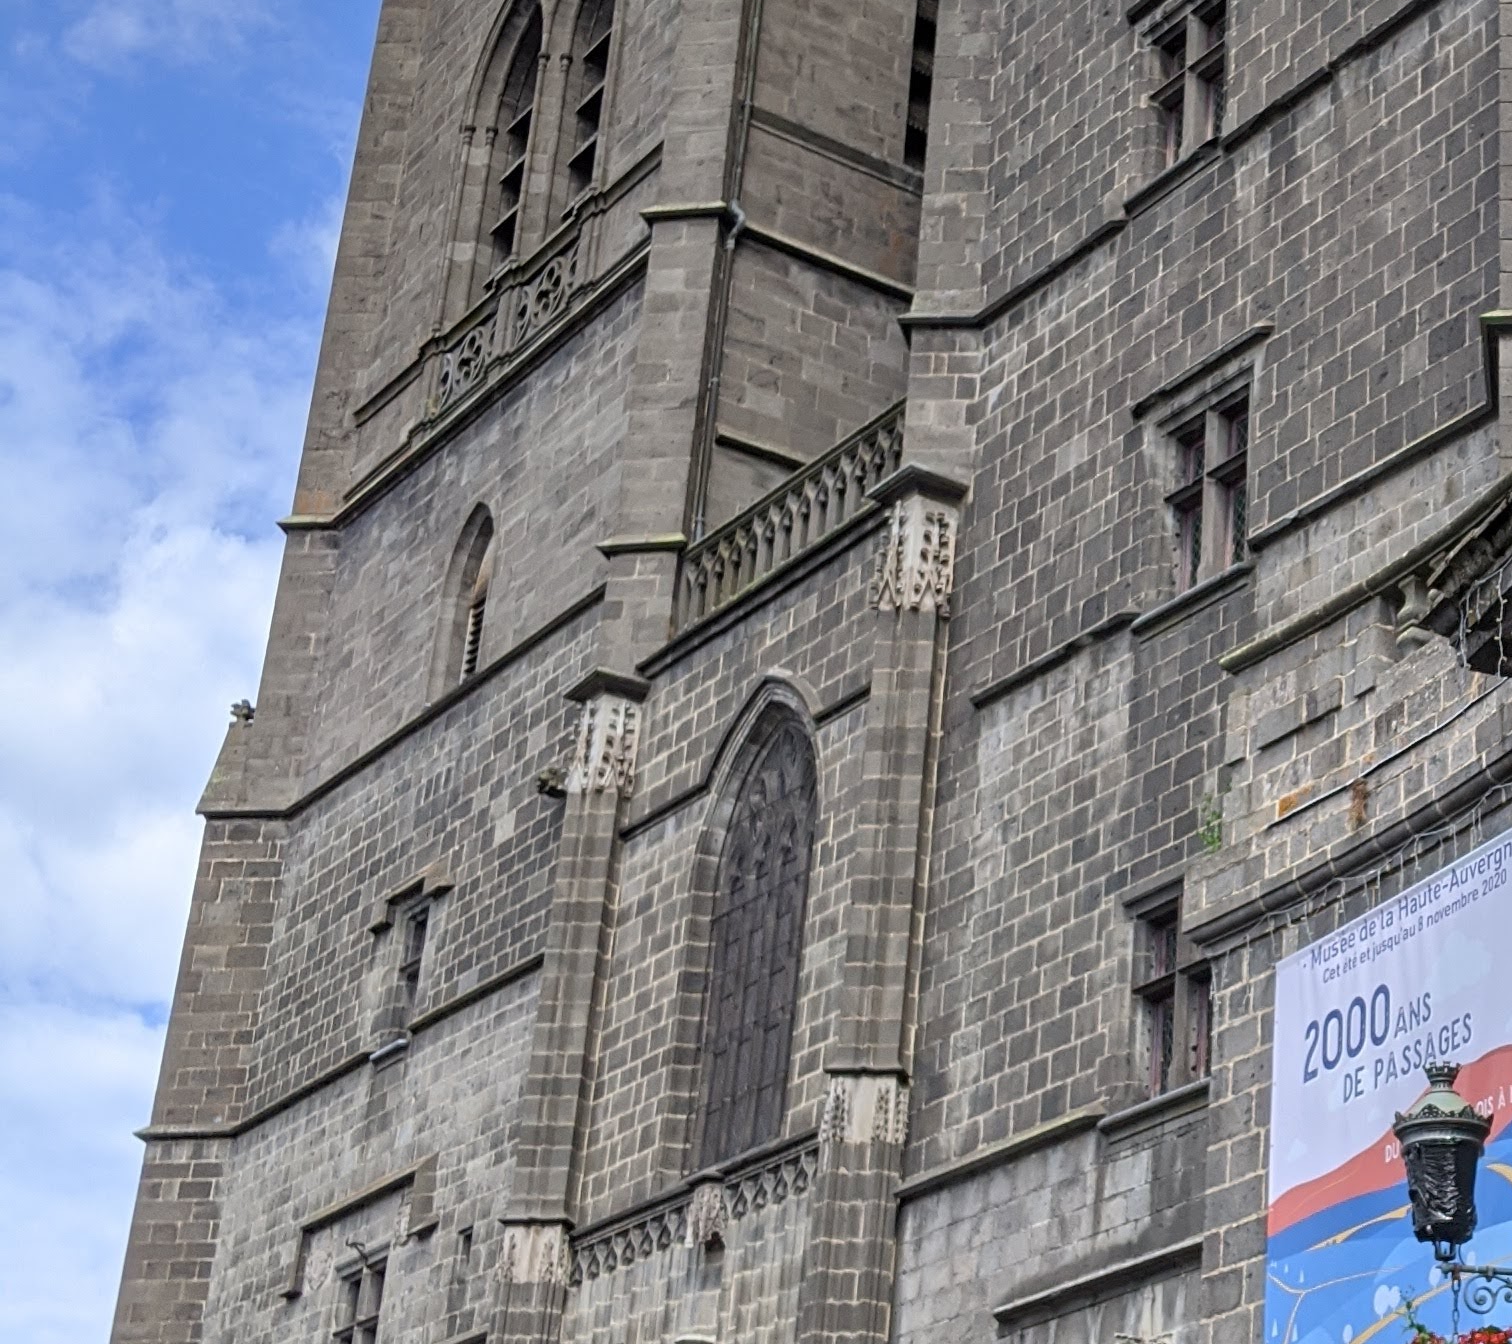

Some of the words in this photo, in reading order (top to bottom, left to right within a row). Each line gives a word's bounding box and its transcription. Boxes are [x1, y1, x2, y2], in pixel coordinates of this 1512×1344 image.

[1310, 931, 1355, 970] Musée
[1359, 922, 1377, 942] de
[1380, 909, 1394, 931] la
[1322, 963, 1340, 984] Cet
[1343, 952, 1358, 975] été
[1360, 948, 1371, 964] et
[1371, 923, 1416, 963] jusqu'au
[1418, 915, 1425, 932] 8
[1426, 884, 1479, 927] novembre
[1482, 868, 1508, 897] 2020
[1303, 984, 1391, 1084] 2000
[1394, 992, 1432, 1039] ANS
[1343, 1065, 1365, 1104] DE
[1374, 1012, 1472, 1090] PASSAGES
[1498, 1086, 1507, 1109] À
